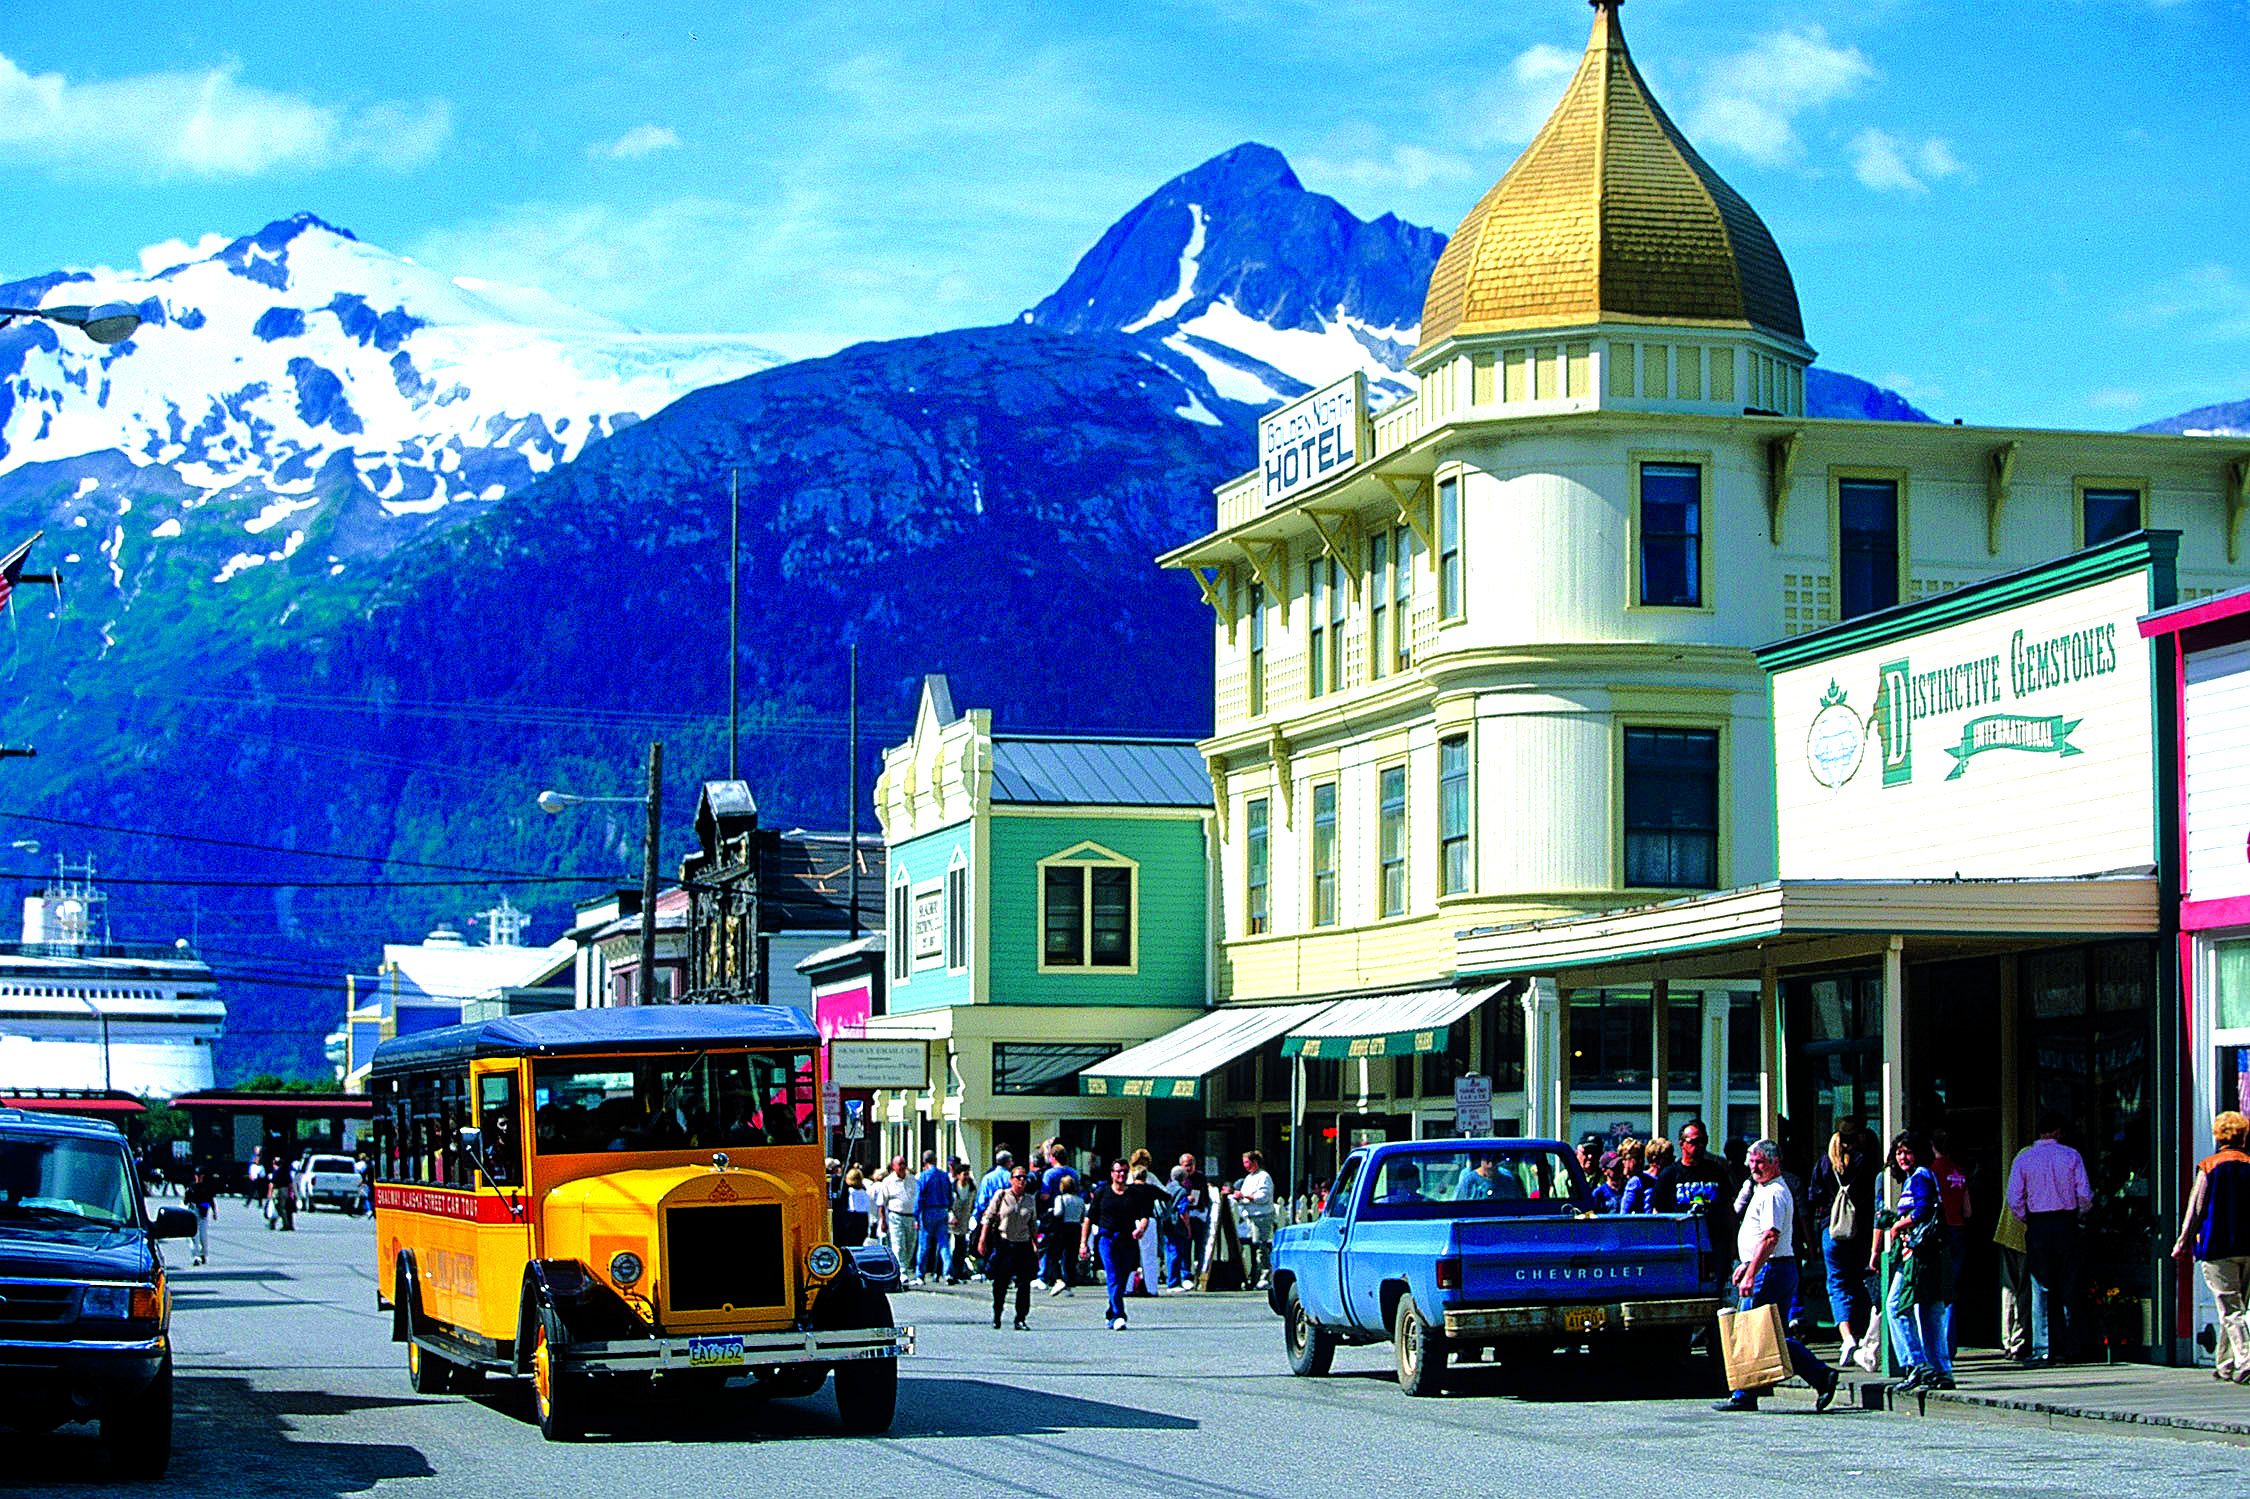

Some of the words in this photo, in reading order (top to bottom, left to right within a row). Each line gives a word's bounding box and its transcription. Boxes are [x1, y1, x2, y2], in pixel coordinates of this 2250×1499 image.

[1267, 413, 1315, 454] GOLDEN
[1313, 389, 1353, 427] NORTH
[1265, 423, 1354, 497] HOTEL
[1885, 655, 2000, 767] DISTINCTIVE
[2011, 622, 2117, 700] GEMSTONES
[1973, 719, 2055, 749] INTERNATIONAL
[377, 1188, 401, 1206] SKAGWAY
[402, 1191, 423, 1209] ALASKA
[424, 1193, 446, 1212] STREET
[447, 1196, 460, 1215] CAR
[461, 1197, 478, 1217] TOUR
[1515, 1266, 1644, 1281] CHEVROLET
